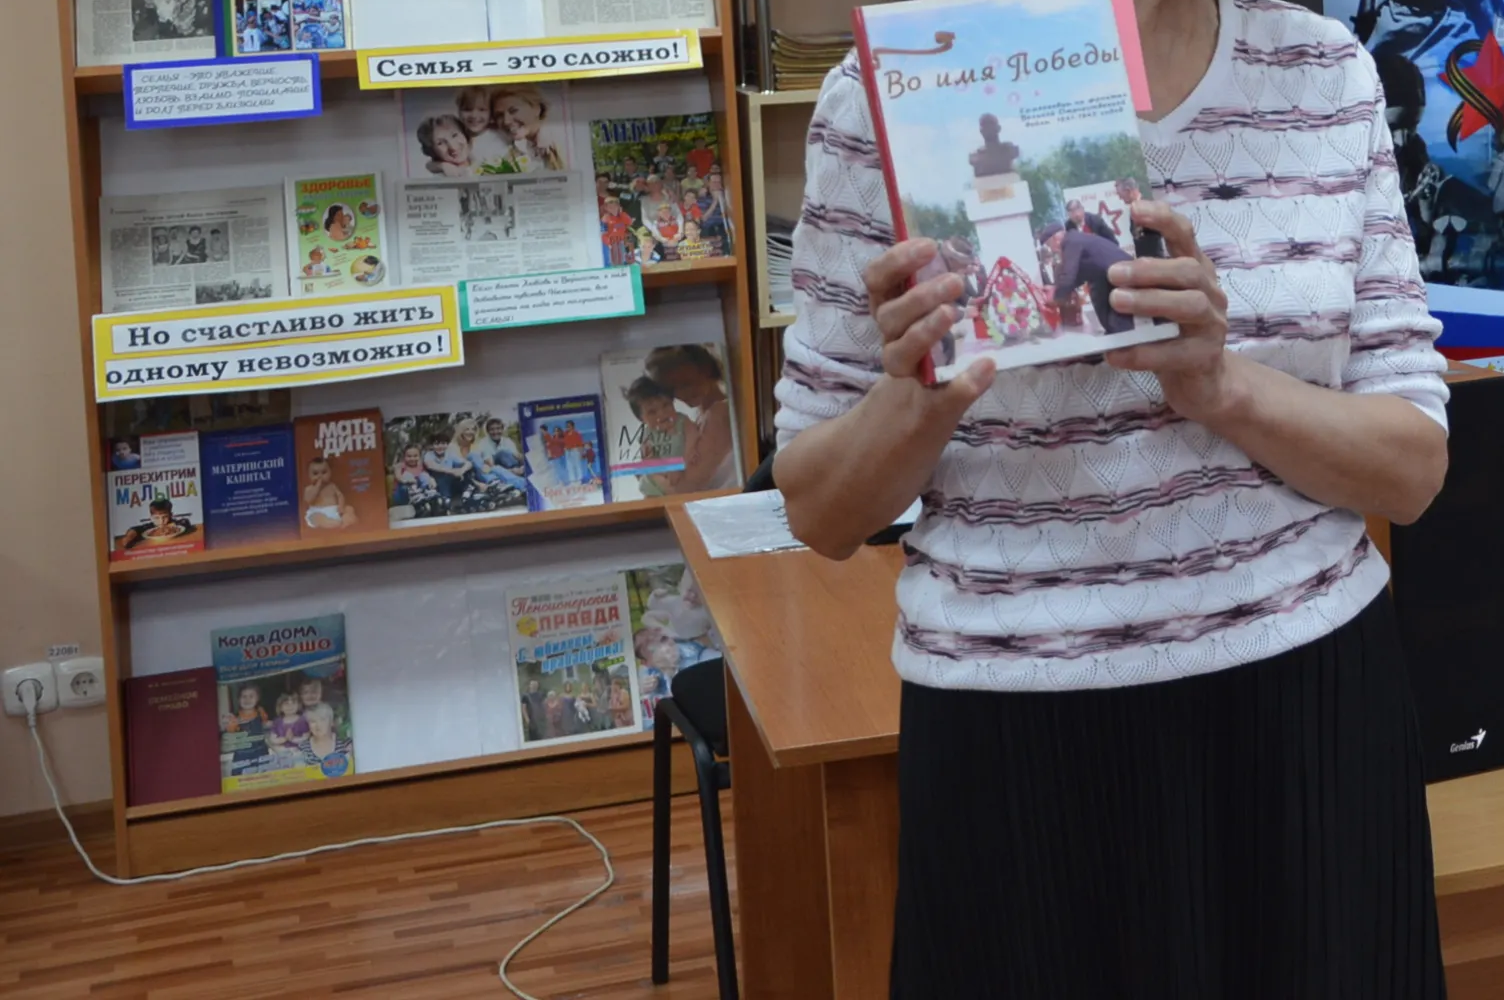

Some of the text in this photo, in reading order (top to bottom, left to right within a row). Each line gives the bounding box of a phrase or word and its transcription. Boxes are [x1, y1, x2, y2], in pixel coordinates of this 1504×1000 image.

[377, 59, 473, 77] Семья
[508, 52, 557, 69] это
[563, 42, 679, 66] сложно!
[884, 42, 1120, 99] Во имя Победы
[302, 177, 372, 193] ЗДОРОВЬЕ
[128, 304, 434, 347] Но счастливо жить
[106, 335, 444, 386] одному невозможно!
[323, 433, 377, 458] ДИТЯ
[114, 467, 196, 487] ПЕРЕХИТРИМ
[211, 457, 285, 476] МАТЕРИНСКИЙ
[226, 471, 272, 486] КАПИТАЛ
[116, 481, 198, 509] МАЛЫША
[511, 592, 619, 618] Пенсионерская
[539, 605, 620, 632] ПРАВДА
[218, 625, 317, 649] Когда ДОМА
[243, 638, 332, 661] ХОРОШО
[158, 700, 189, 711] ПРАВО
[1450, 740, 1475, 754] Genius
